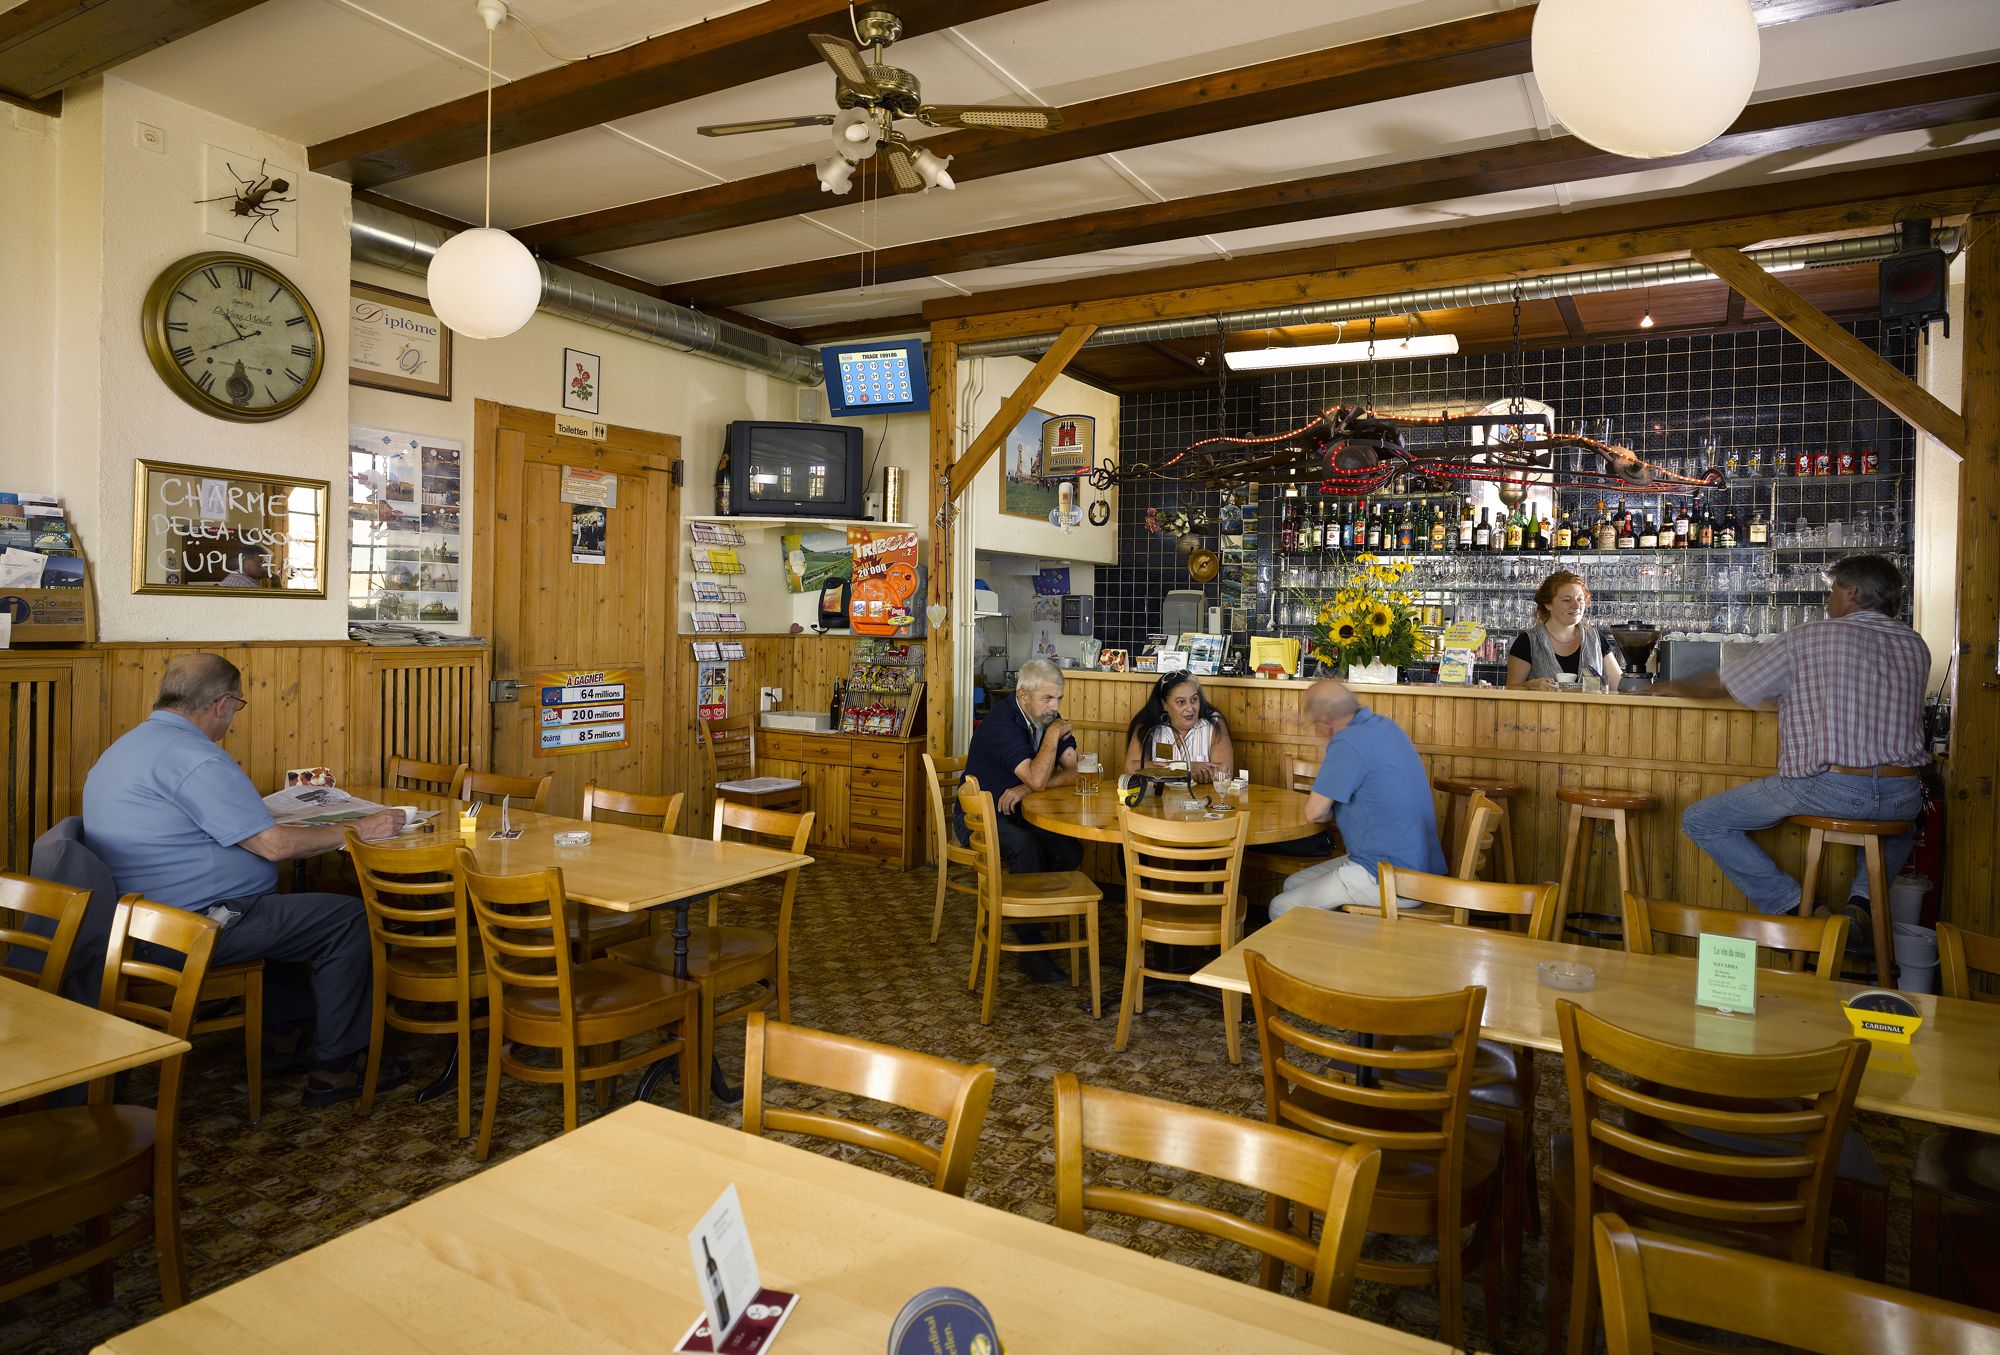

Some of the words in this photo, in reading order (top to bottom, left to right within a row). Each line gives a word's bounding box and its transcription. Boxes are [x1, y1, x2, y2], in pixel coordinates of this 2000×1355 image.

[352, 303, 437, 336] Diplôme
[557, 423, 588, 437] Toiletten
[160, 478, 288, 517] CHARME
[853, 532, 918, 558] TRIBOLO
[157, 540, 244, 574] CÜPLI
[858, 563, 887, 578] 20'000
[566, 675, 573, 687] À
[574, 673, 604, 686] GAGNER
[581, 689, 594, 699] 64
[594, 690, 621, 699] millions
[594, 710, 620, 719] millions
[594, 730, 621, 740] millions
[1864, 1022, 1902, 1033] CARDINAL
